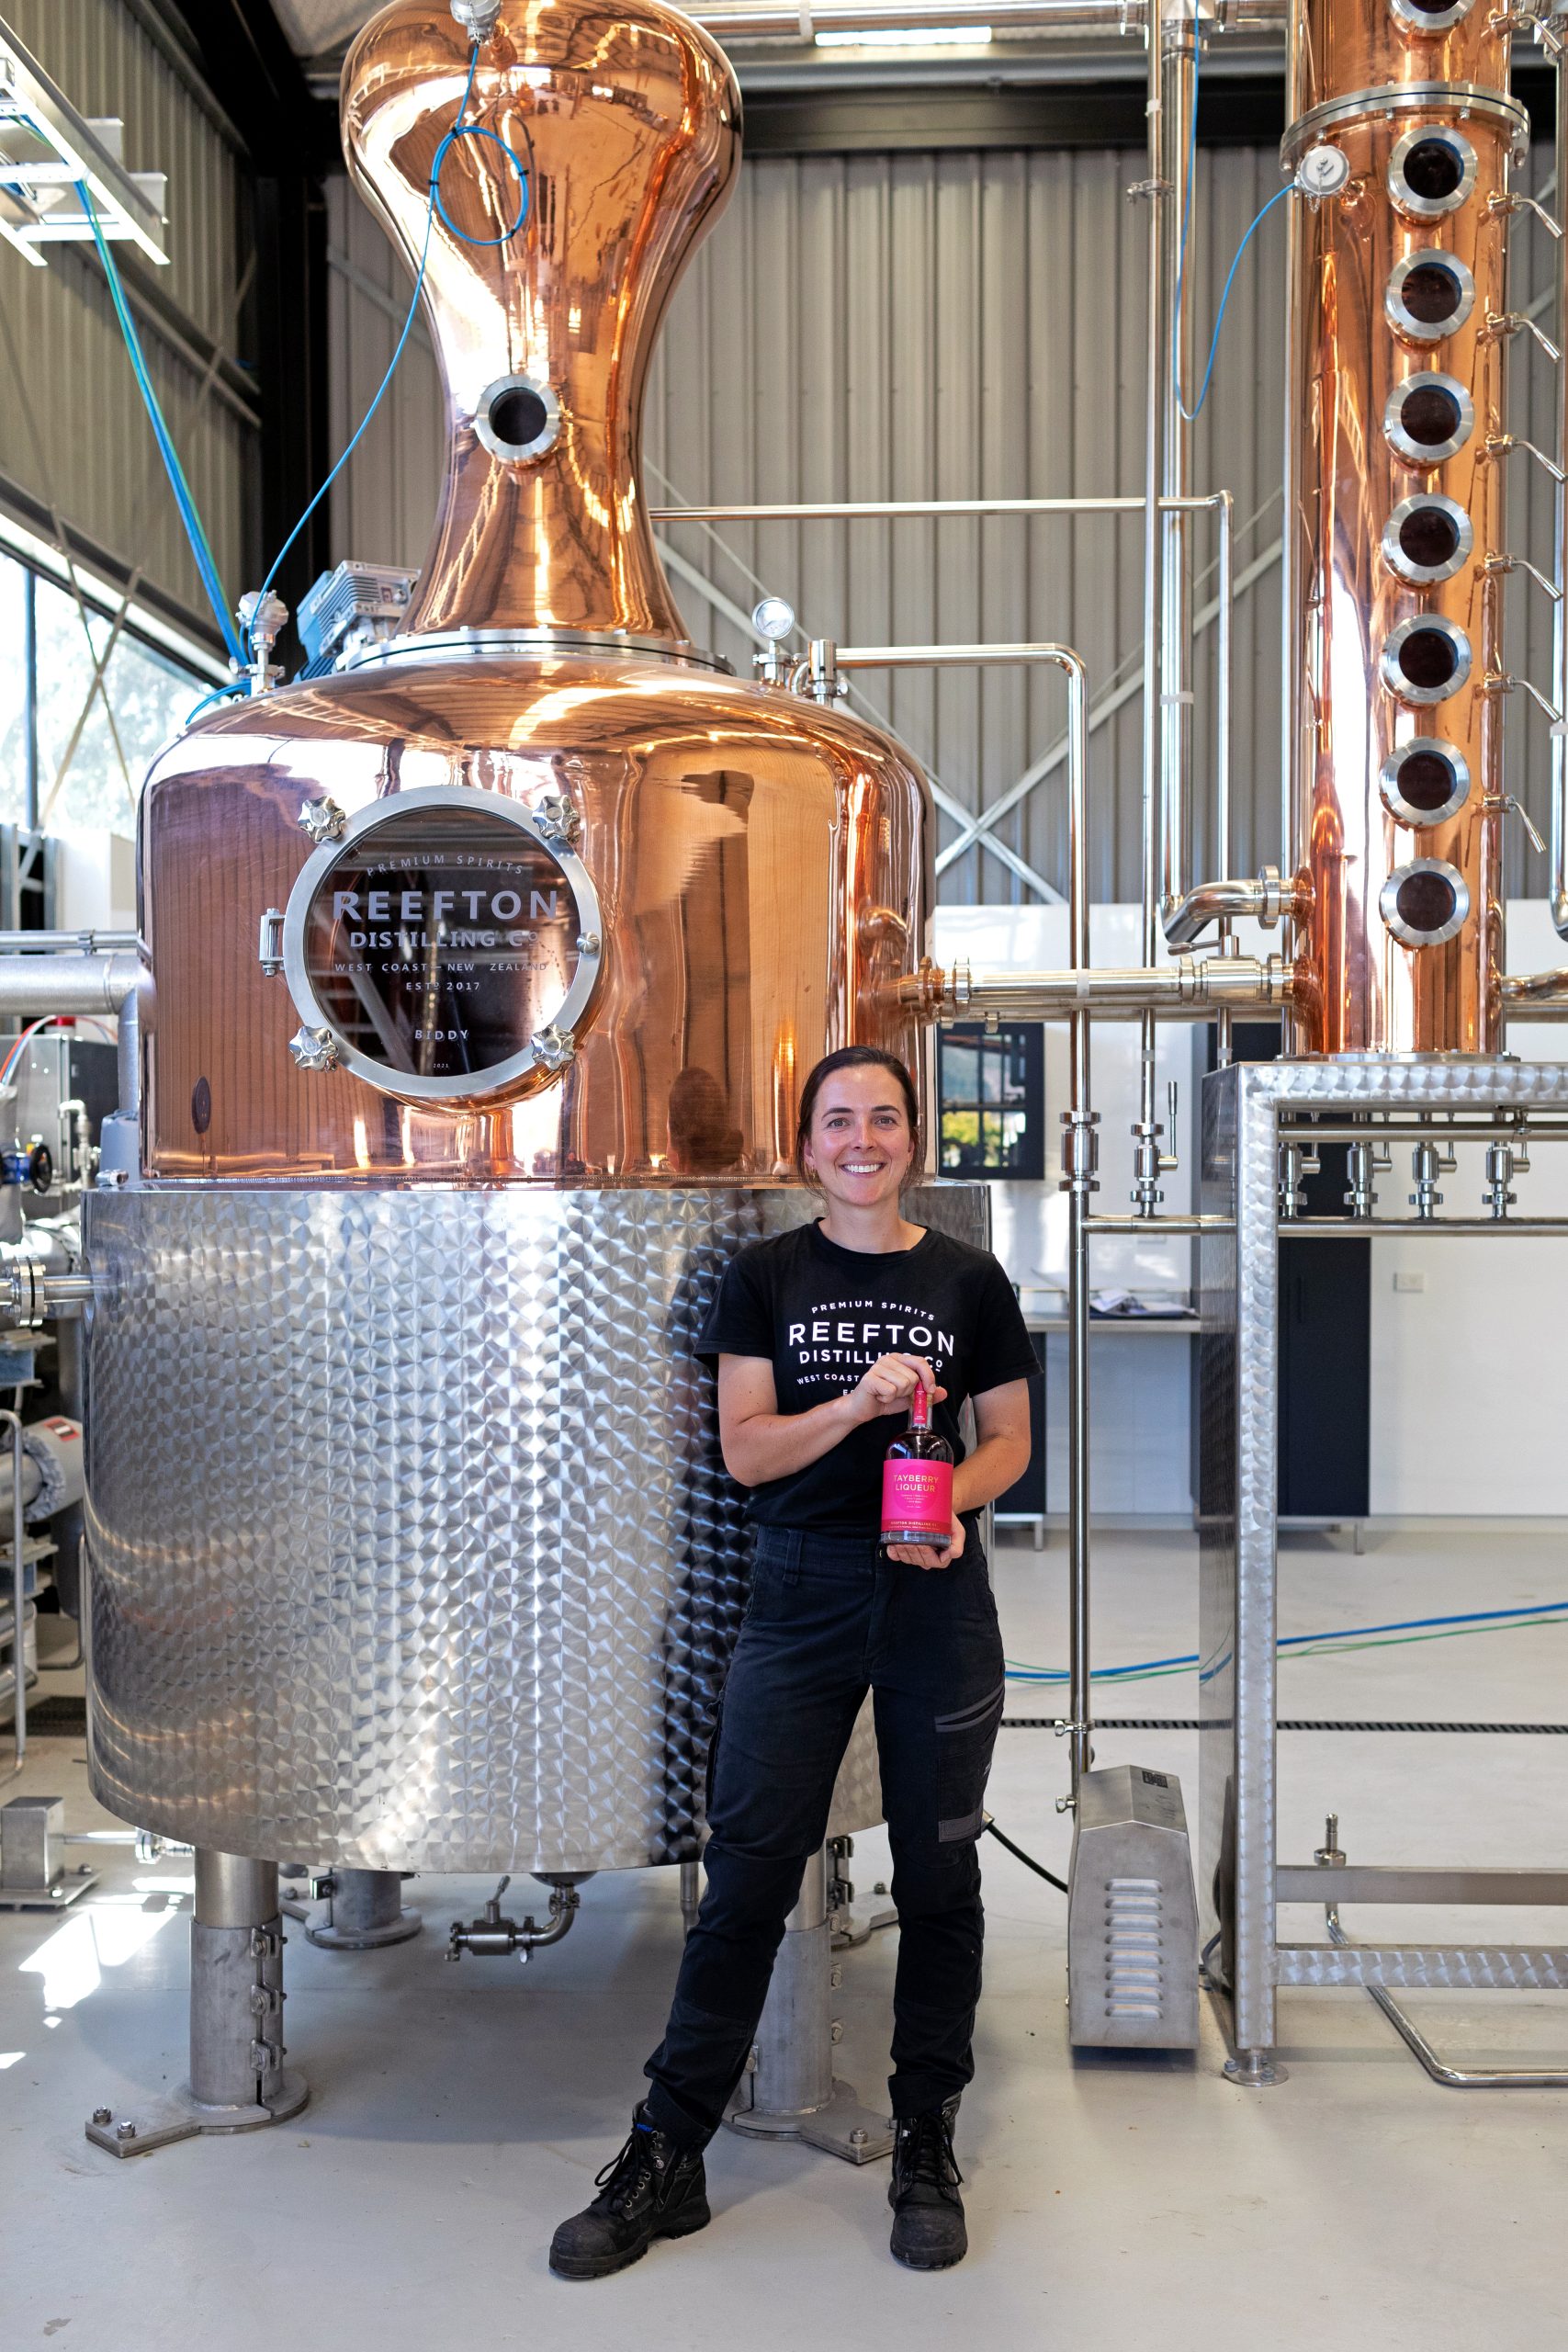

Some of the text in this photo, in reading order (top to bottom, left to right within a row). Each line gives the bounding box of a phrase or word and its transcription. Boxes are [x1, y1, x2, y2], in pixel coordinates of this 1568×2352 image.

[367, 854, 523, 876] PREMIUM SPIRITS
[333, 890, 557, 922] REEFTON
[350, 931, 495, 948] DISTILLING
[335, 963, 372, 972] WEST
[381, 963, 428, 972] COAST
[447, 963, 475, 972] NEW
[490, 963, 547, 972] ZEALAND
[446, 981, 480, 991] 2017
[414, 1029, 468, 1041] BIDDY
[811, 1300, 935, 1321] PREMIUM SPIRITS
[788, 1321, 954, 1357] REEFTON
[796, 1373, 860, 1385] WEST COAST
[893, 1475, 939, 1484] TAYBERRY
[896, 1484, 935, 1492] LIQUEUR
